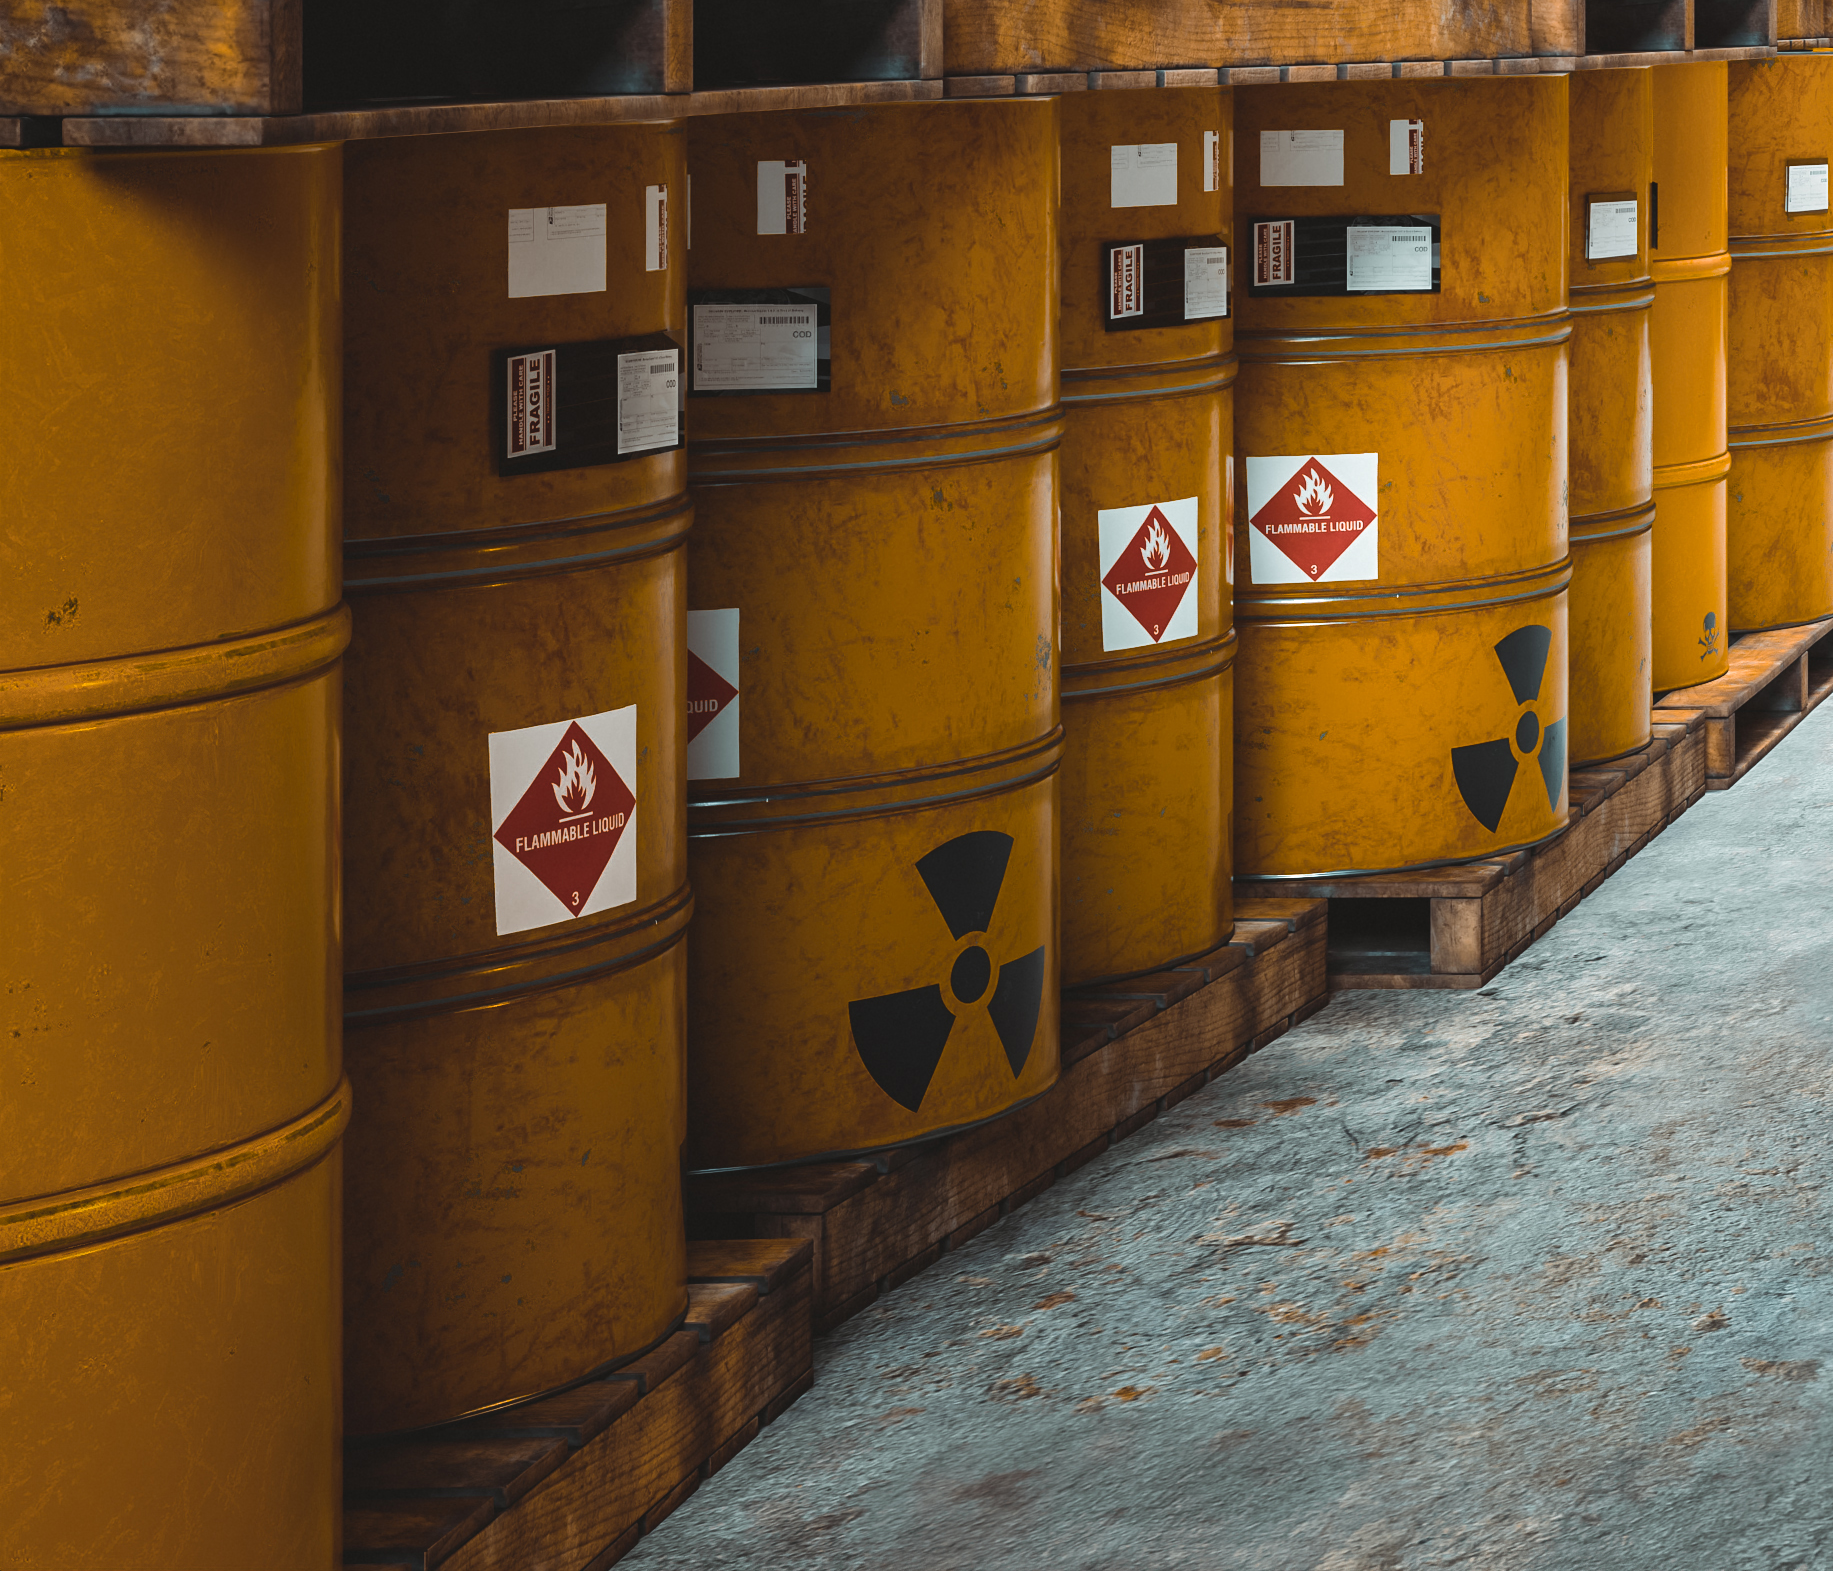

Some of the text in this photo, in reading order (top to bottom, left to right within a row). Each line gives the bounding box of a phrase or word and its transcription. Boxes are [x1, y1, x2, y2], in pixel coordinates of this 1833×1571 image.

[1272, 226, 1281, 280] FRAGILE
[793, 330, 812, 339] COD
[530, 358, 540, 446] FRAGILE
[1265, 520, 1364, 535] FLAMMABLE LIQUID
[1310, 565, 1318, 575] 3
[1116, 571, 1190, 595] FLAMMABLE LIQUID
[1153, 625, 1160, 635] 3
[687, 699, 719, 714] QUID
[515, 812, 625, 853] FLAMMABLE LIQUID
[571, 891, 580, 906] 3
